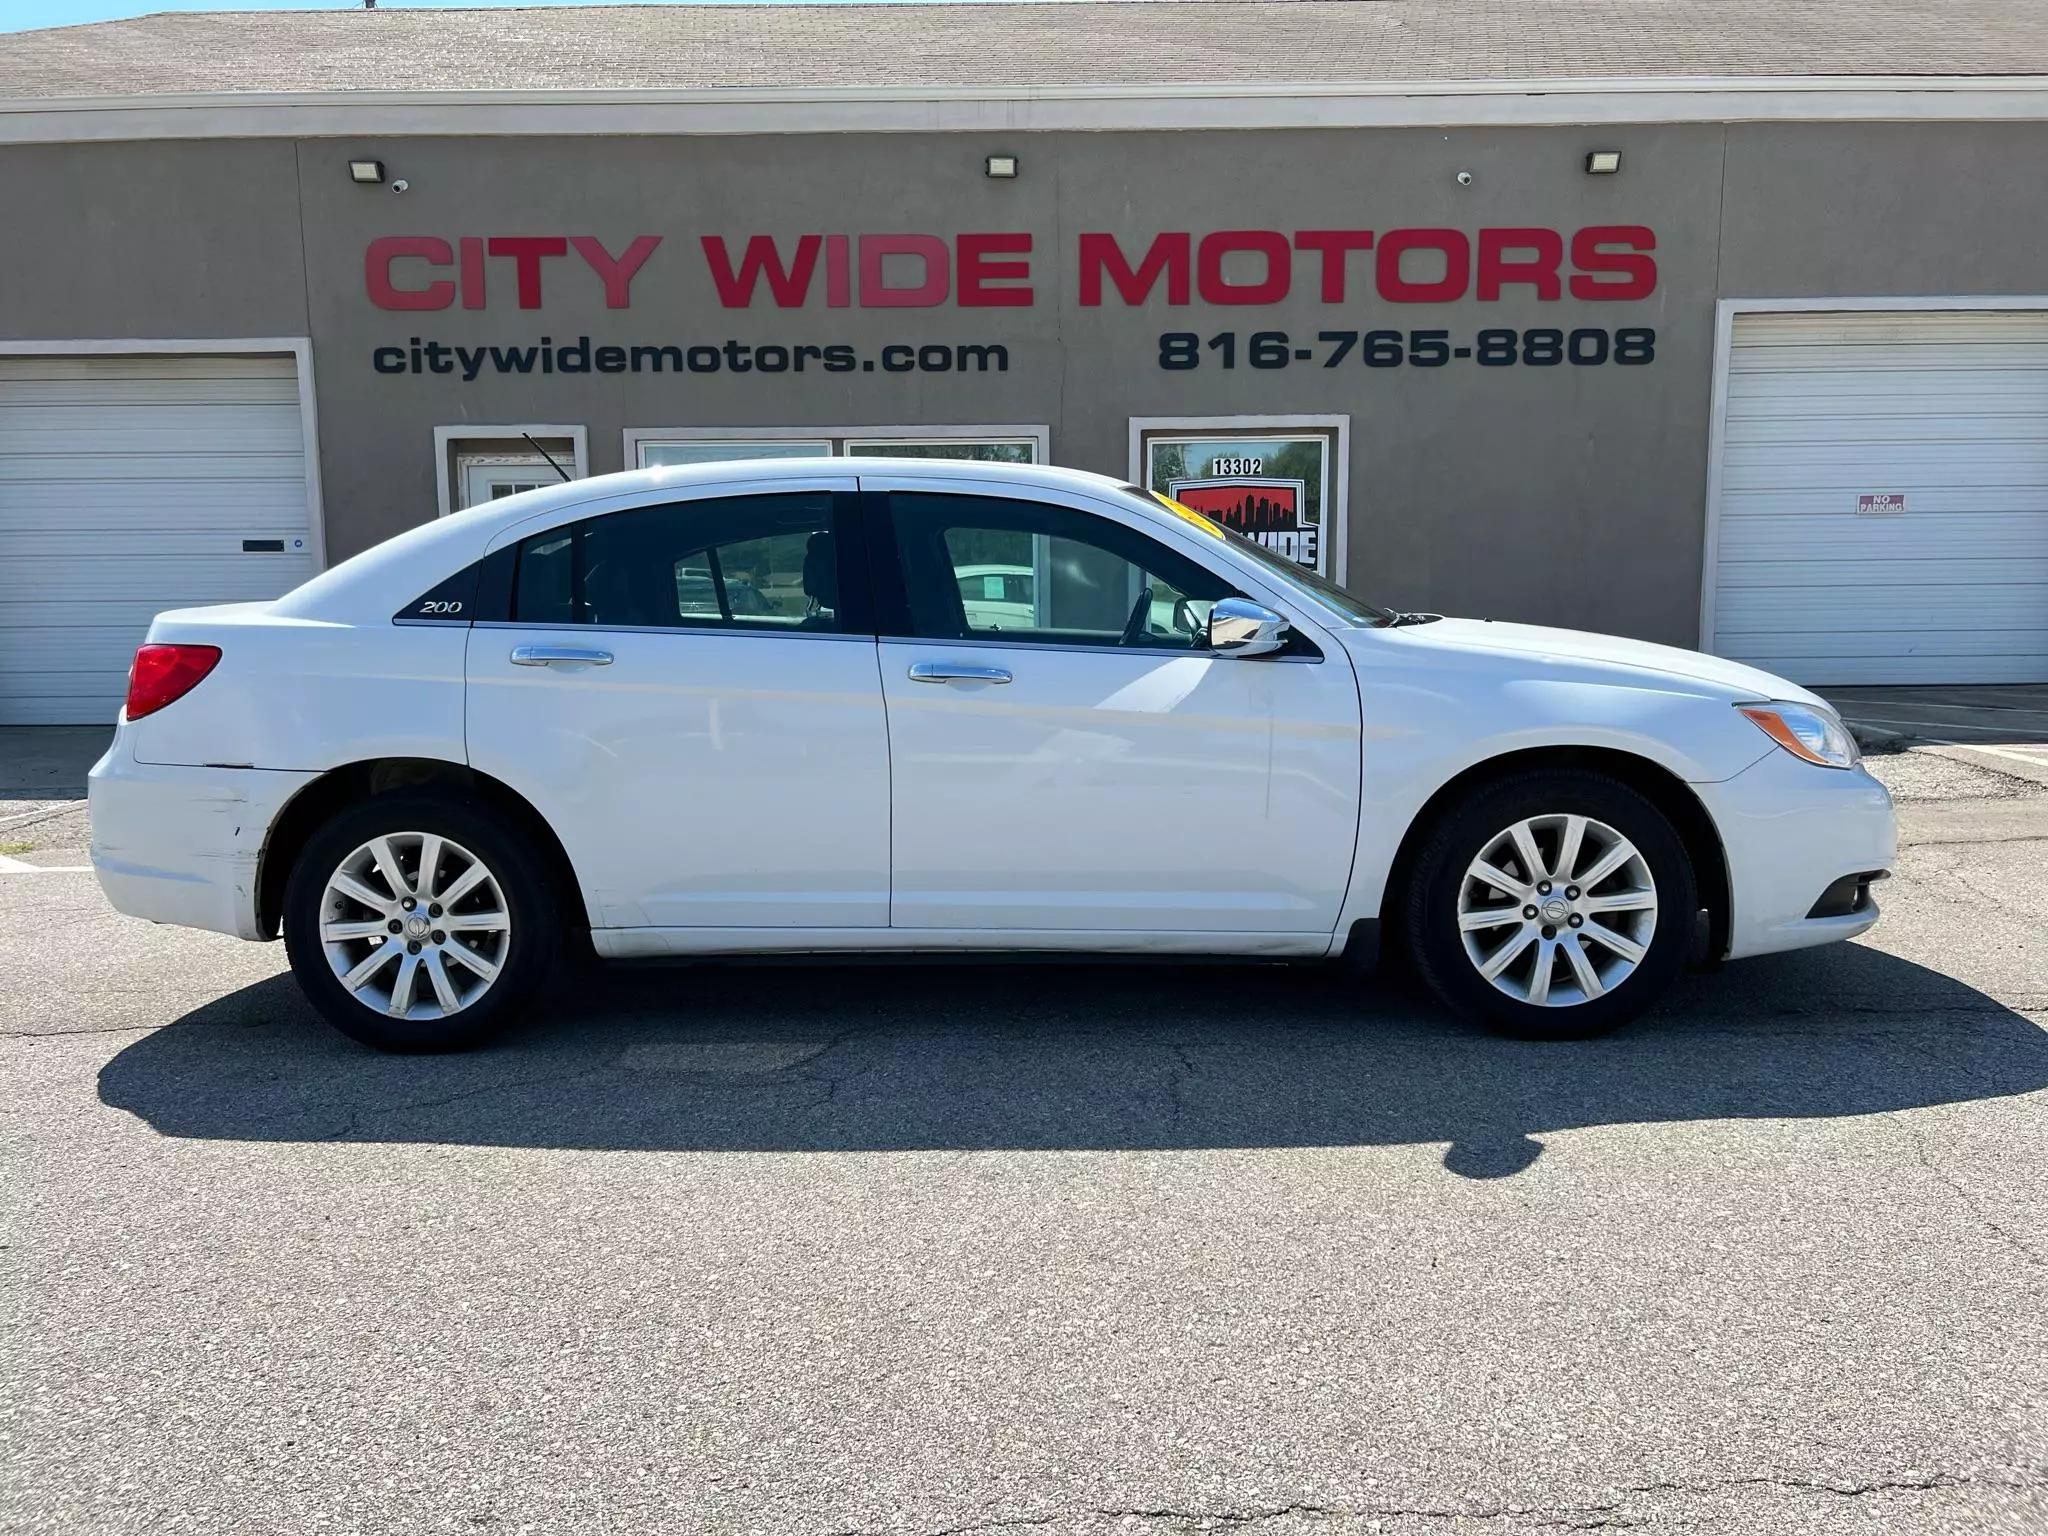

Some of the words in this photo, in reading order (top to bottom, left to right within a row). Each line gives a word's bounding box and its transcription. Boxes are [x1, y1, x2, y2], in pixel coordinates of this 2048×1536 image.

[364, 235, 663, 311] CITY
[700, 233, 1034, 309] WIDE
[1079, 225, 1657, 307] MOTORS
[372, 336, 1009, 382] citywidemotors.com
[1158, 327, 1656, 370] 816-765-8808
[1215, 458, 1261, 475] 13302
[1860, 503, 1902, 512] PARKING
[1873, 495, 1891, 503] NO
[1240, 531, 1317, 564] IDE
[419, 601, 463, 613] 200
